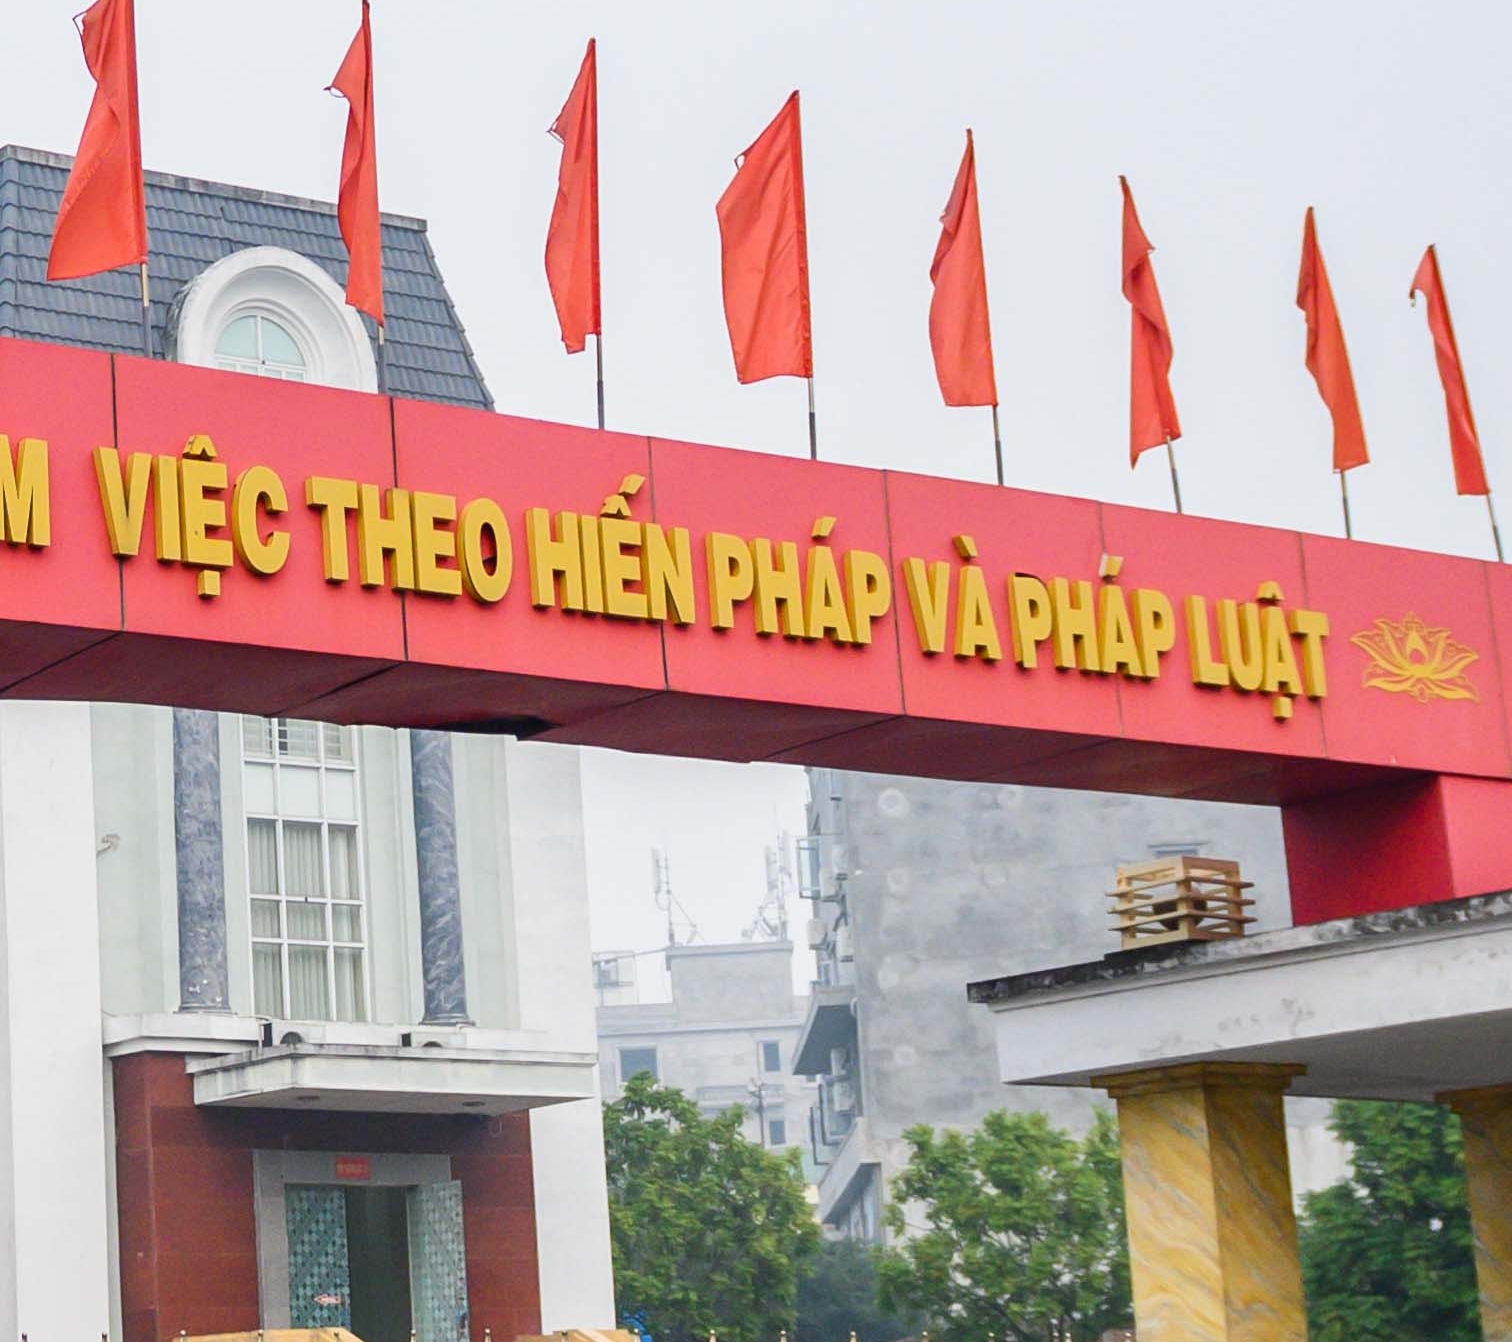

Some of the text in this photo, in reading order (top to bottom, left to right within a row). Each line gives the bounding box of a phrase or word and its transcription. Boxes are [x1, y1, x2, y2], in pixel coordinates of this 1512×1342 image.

[93, 433, 290, 597] VIỆC
[305, 475, 513, 602] THEO
[526, 473, 696, 625] HIẾN
[707, 516, 892, 645] PHÁP
[902, 535, 1003, 662] VÀ
[1007, 555, 1175, 679] PHÁP
[1184, 581, 1330, 720] LUẬT
